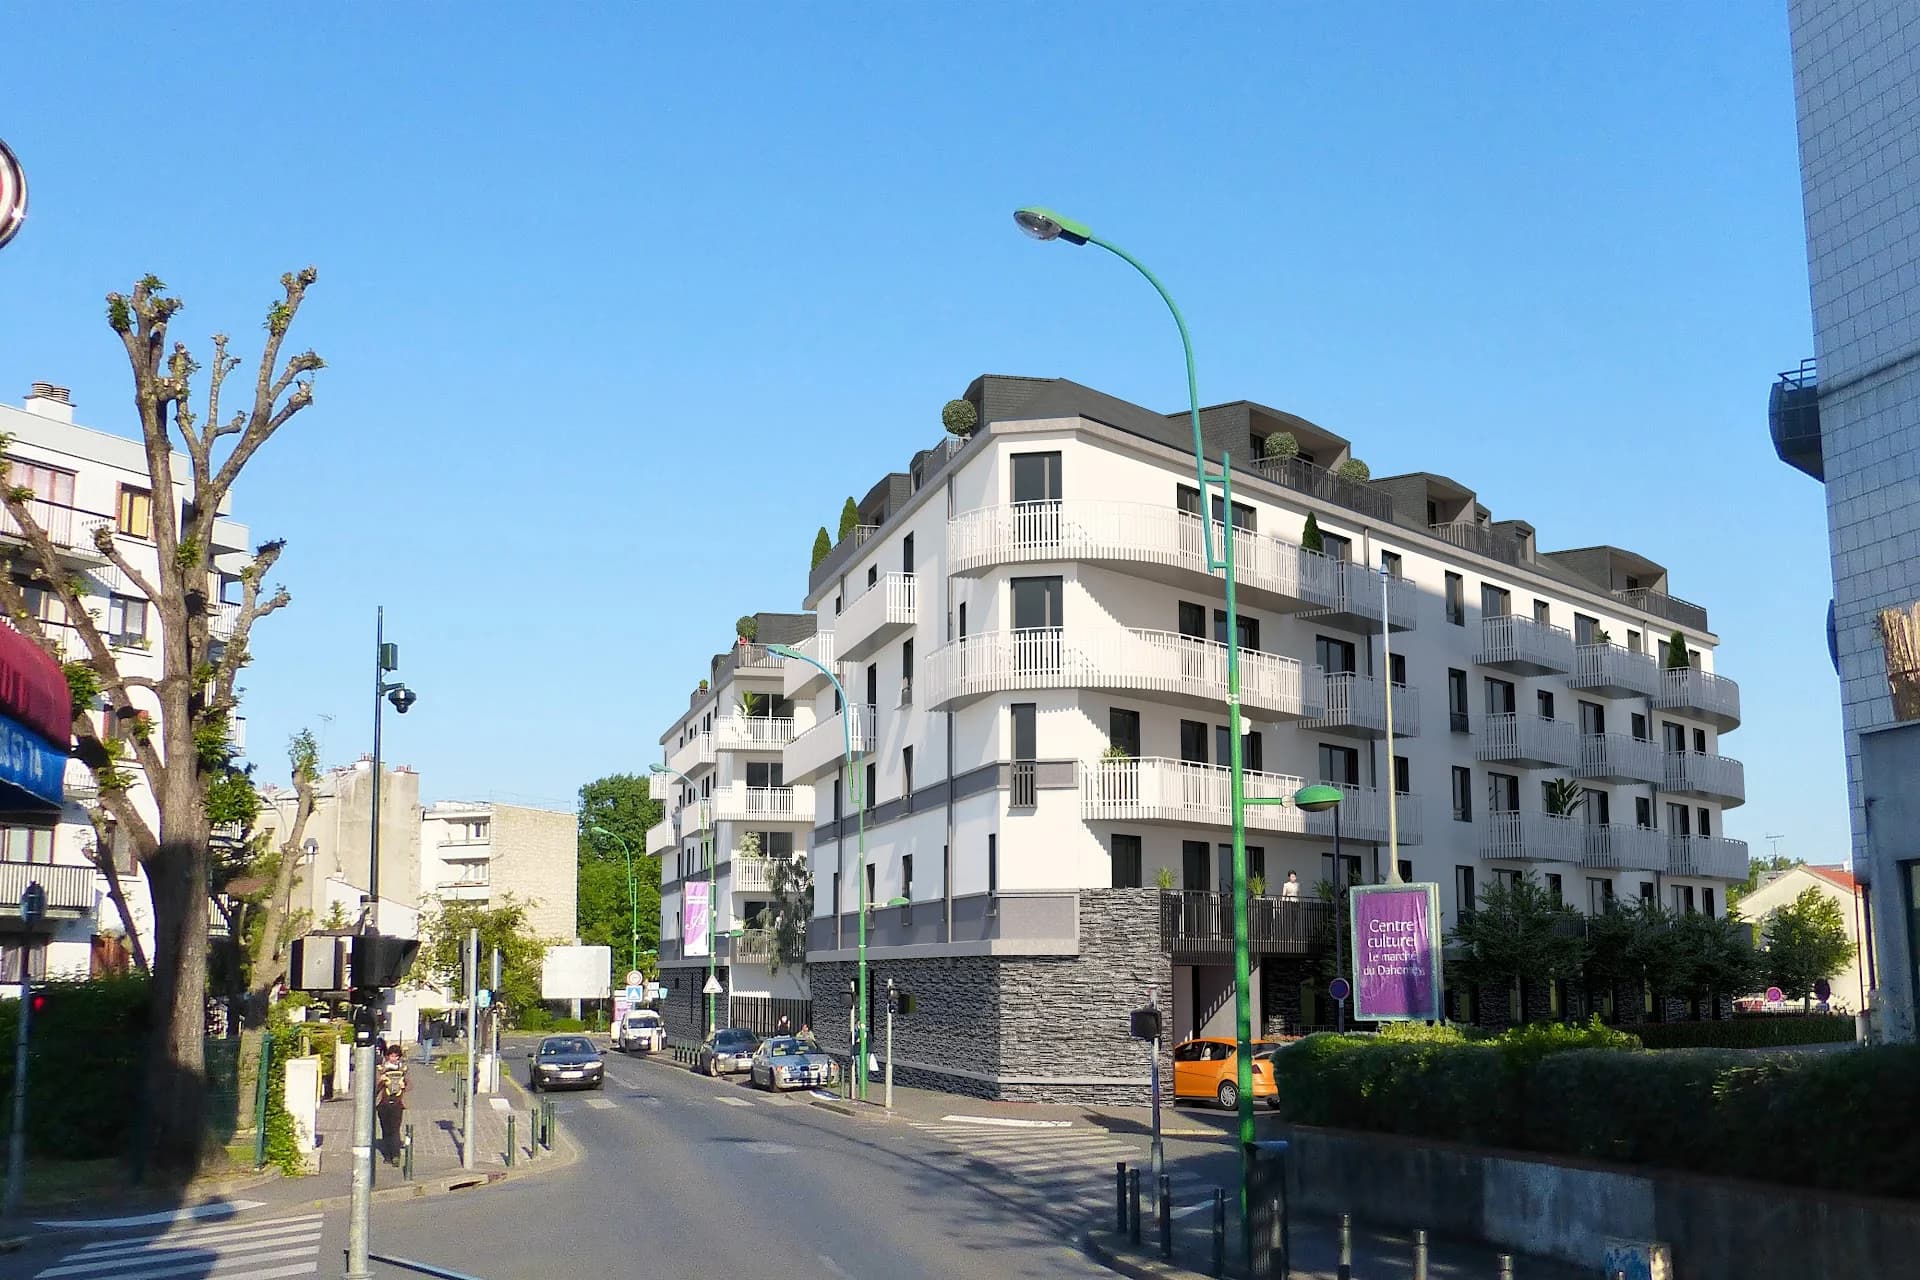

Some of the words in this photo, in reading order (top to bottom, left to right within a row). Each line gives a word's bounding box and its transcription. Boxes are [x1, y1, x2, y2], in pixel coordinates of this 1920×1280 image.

[1369, 919, 1414, 933] Centre
[1367, 933, 1417, 948] culturel
[1363, 964, 1375, 976] du
